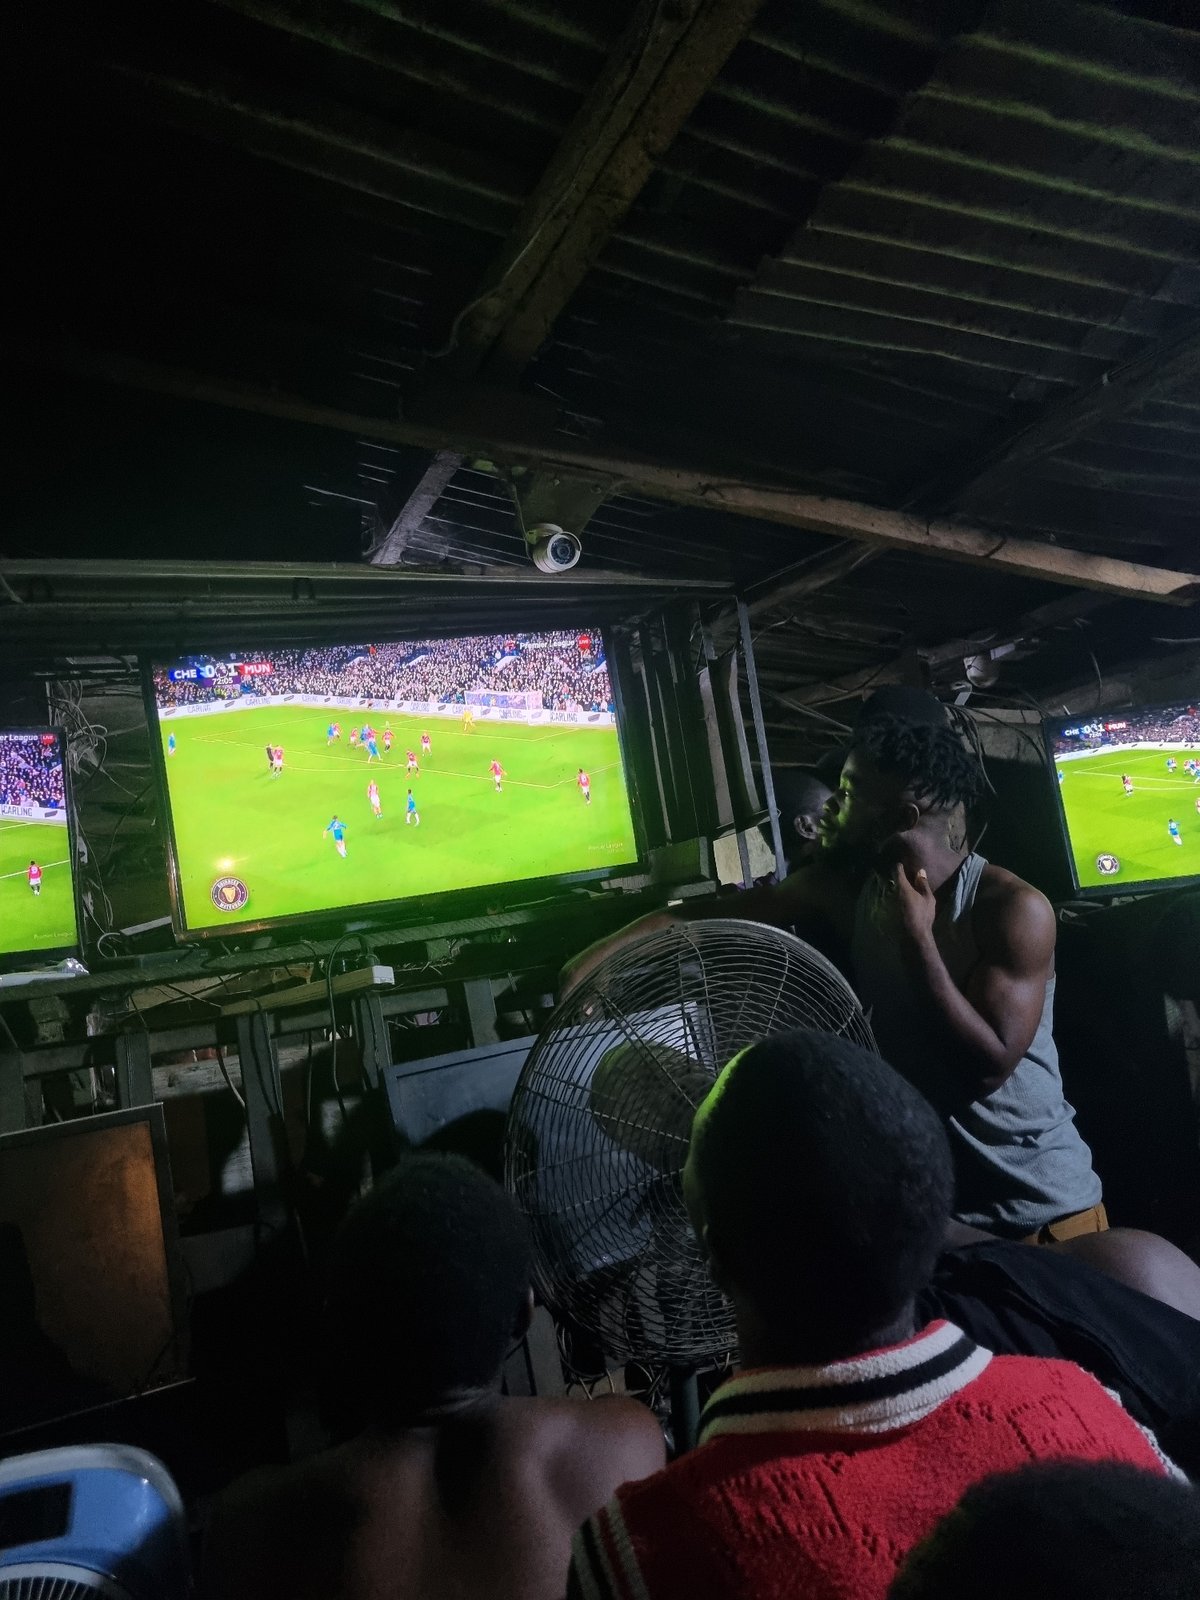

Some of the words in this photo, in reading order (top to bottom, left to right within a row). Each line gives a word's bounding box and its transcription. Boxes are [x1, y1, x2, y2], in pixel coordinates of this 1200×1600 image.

[174, 669, 197, 680] CHE
[205, 664, 215, 678] 0
[228, 665, 238, 677] 1
[244, 663, 271, 674] MUN
[212, 678, 233, 686] 72:05
[551, 712, 578, 723] CARLING
[3, 805, 33, 817] CARLING
